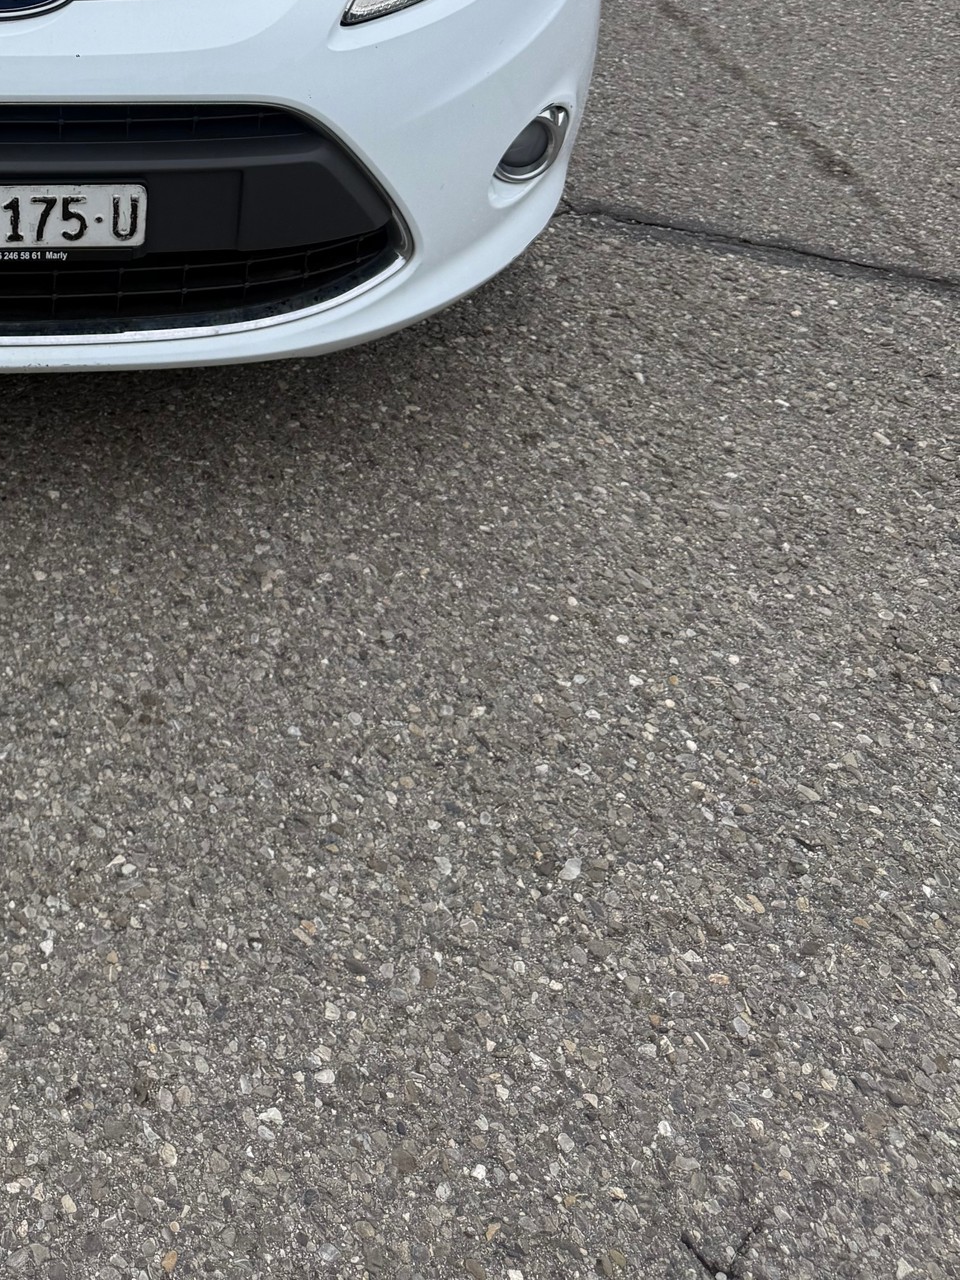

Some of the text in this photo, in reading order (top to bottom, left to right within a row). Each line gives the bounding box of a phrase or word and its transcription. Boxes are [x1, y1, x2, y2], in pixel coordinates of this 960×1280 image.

[3, 252, 19, 260] 246
[20, 252, 30, 260] 58
[31, 251, 41, 260] 61
[45, 251, 68, 261] Marly
